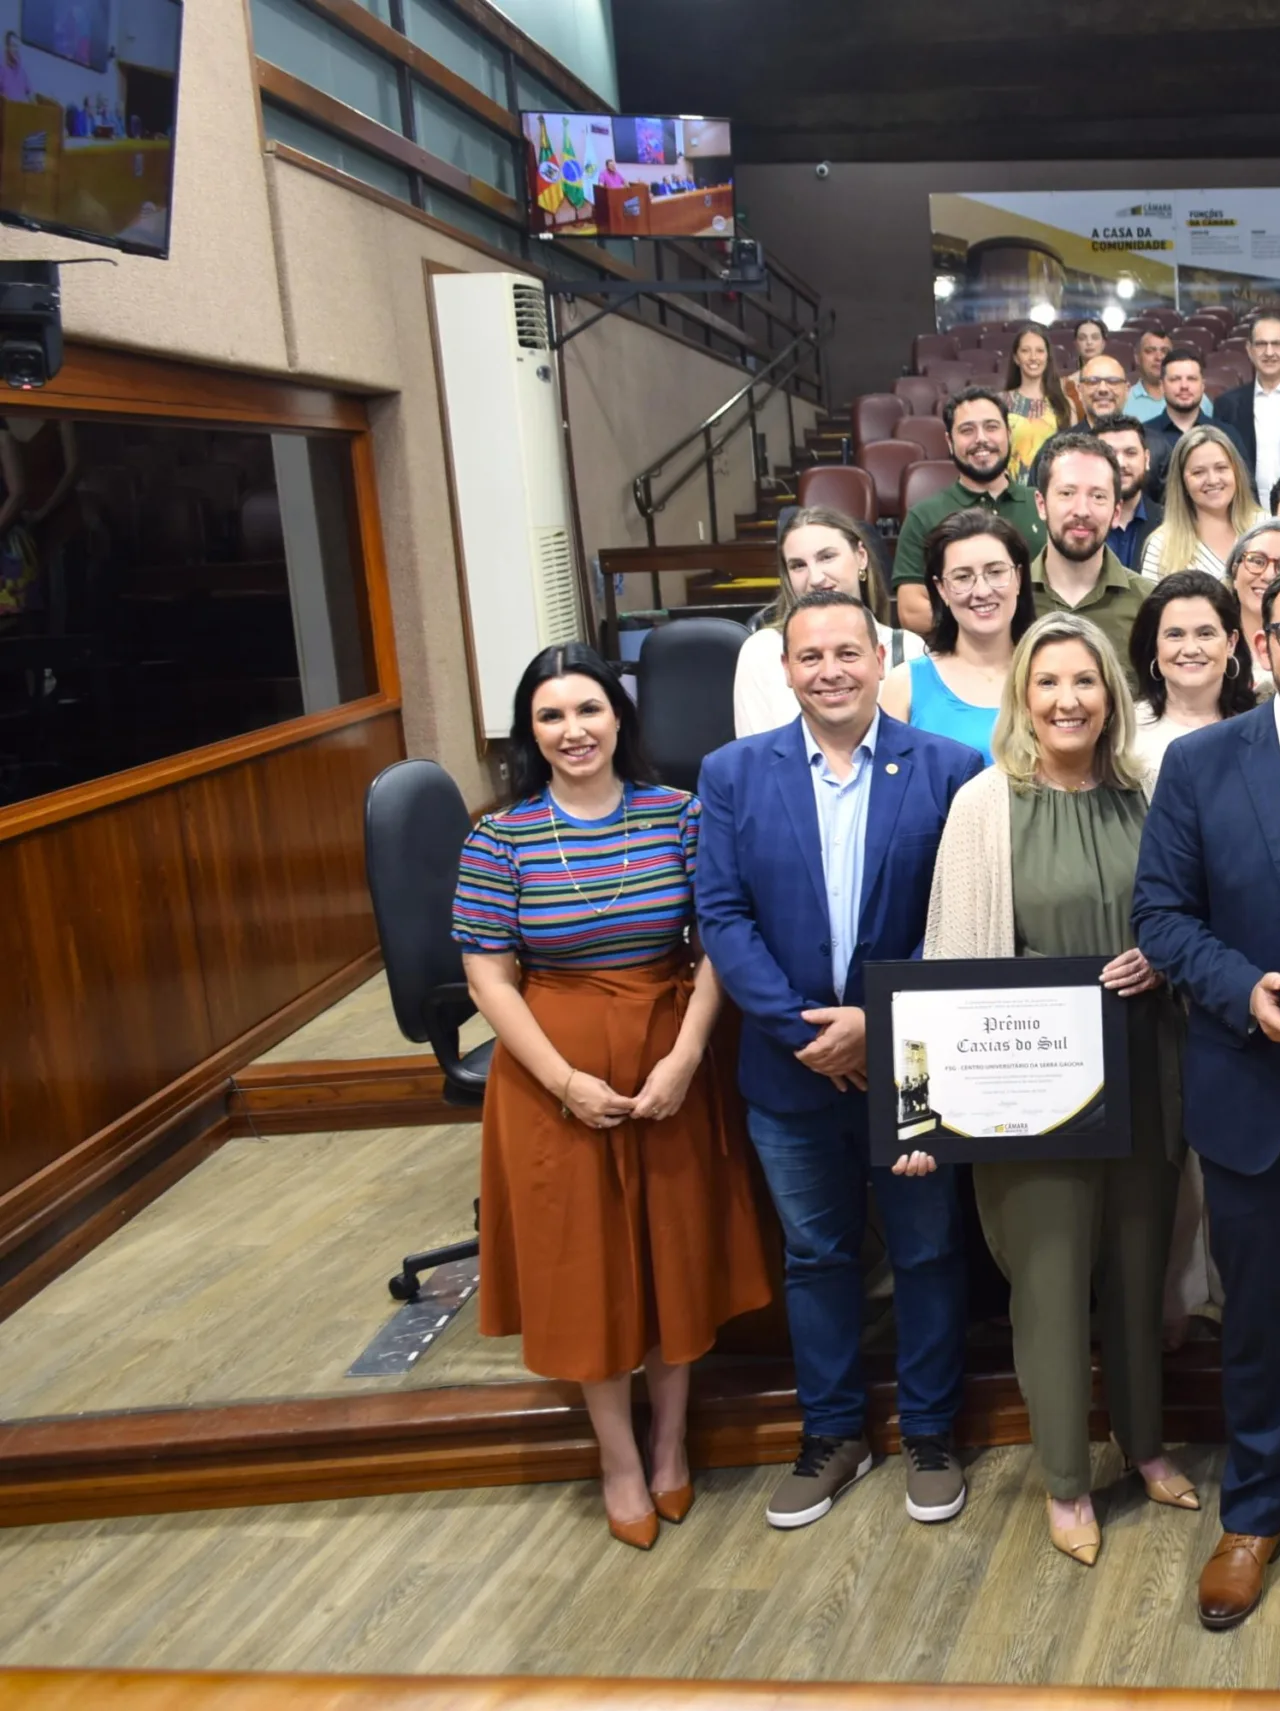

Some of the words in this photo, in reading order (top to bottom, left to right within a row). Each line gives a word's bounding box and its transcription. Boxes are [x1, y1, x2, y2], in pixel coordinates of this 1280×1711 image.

[1189, 208, 1223, 218] FUNÇÕES
[1091, 227, 1100, 238] A
[1103, 227, 1133, 238] CASA
[1136, 226, 1152, 237] DA
[1091, 239, 1167, 252] COMUNIDADE
[982, 1014, 1041, 1034] Prêmio
[957, 1037, 1011, 1054] Caxias
[1015, 1038, 1032, 1051] do
[1037, 1036, 1068, 1051] Sul
[985, 1062, 1029, 1070] UNIVERSITÁRIO
[1059, 1060, 1084, 1068] GAÚCHA
